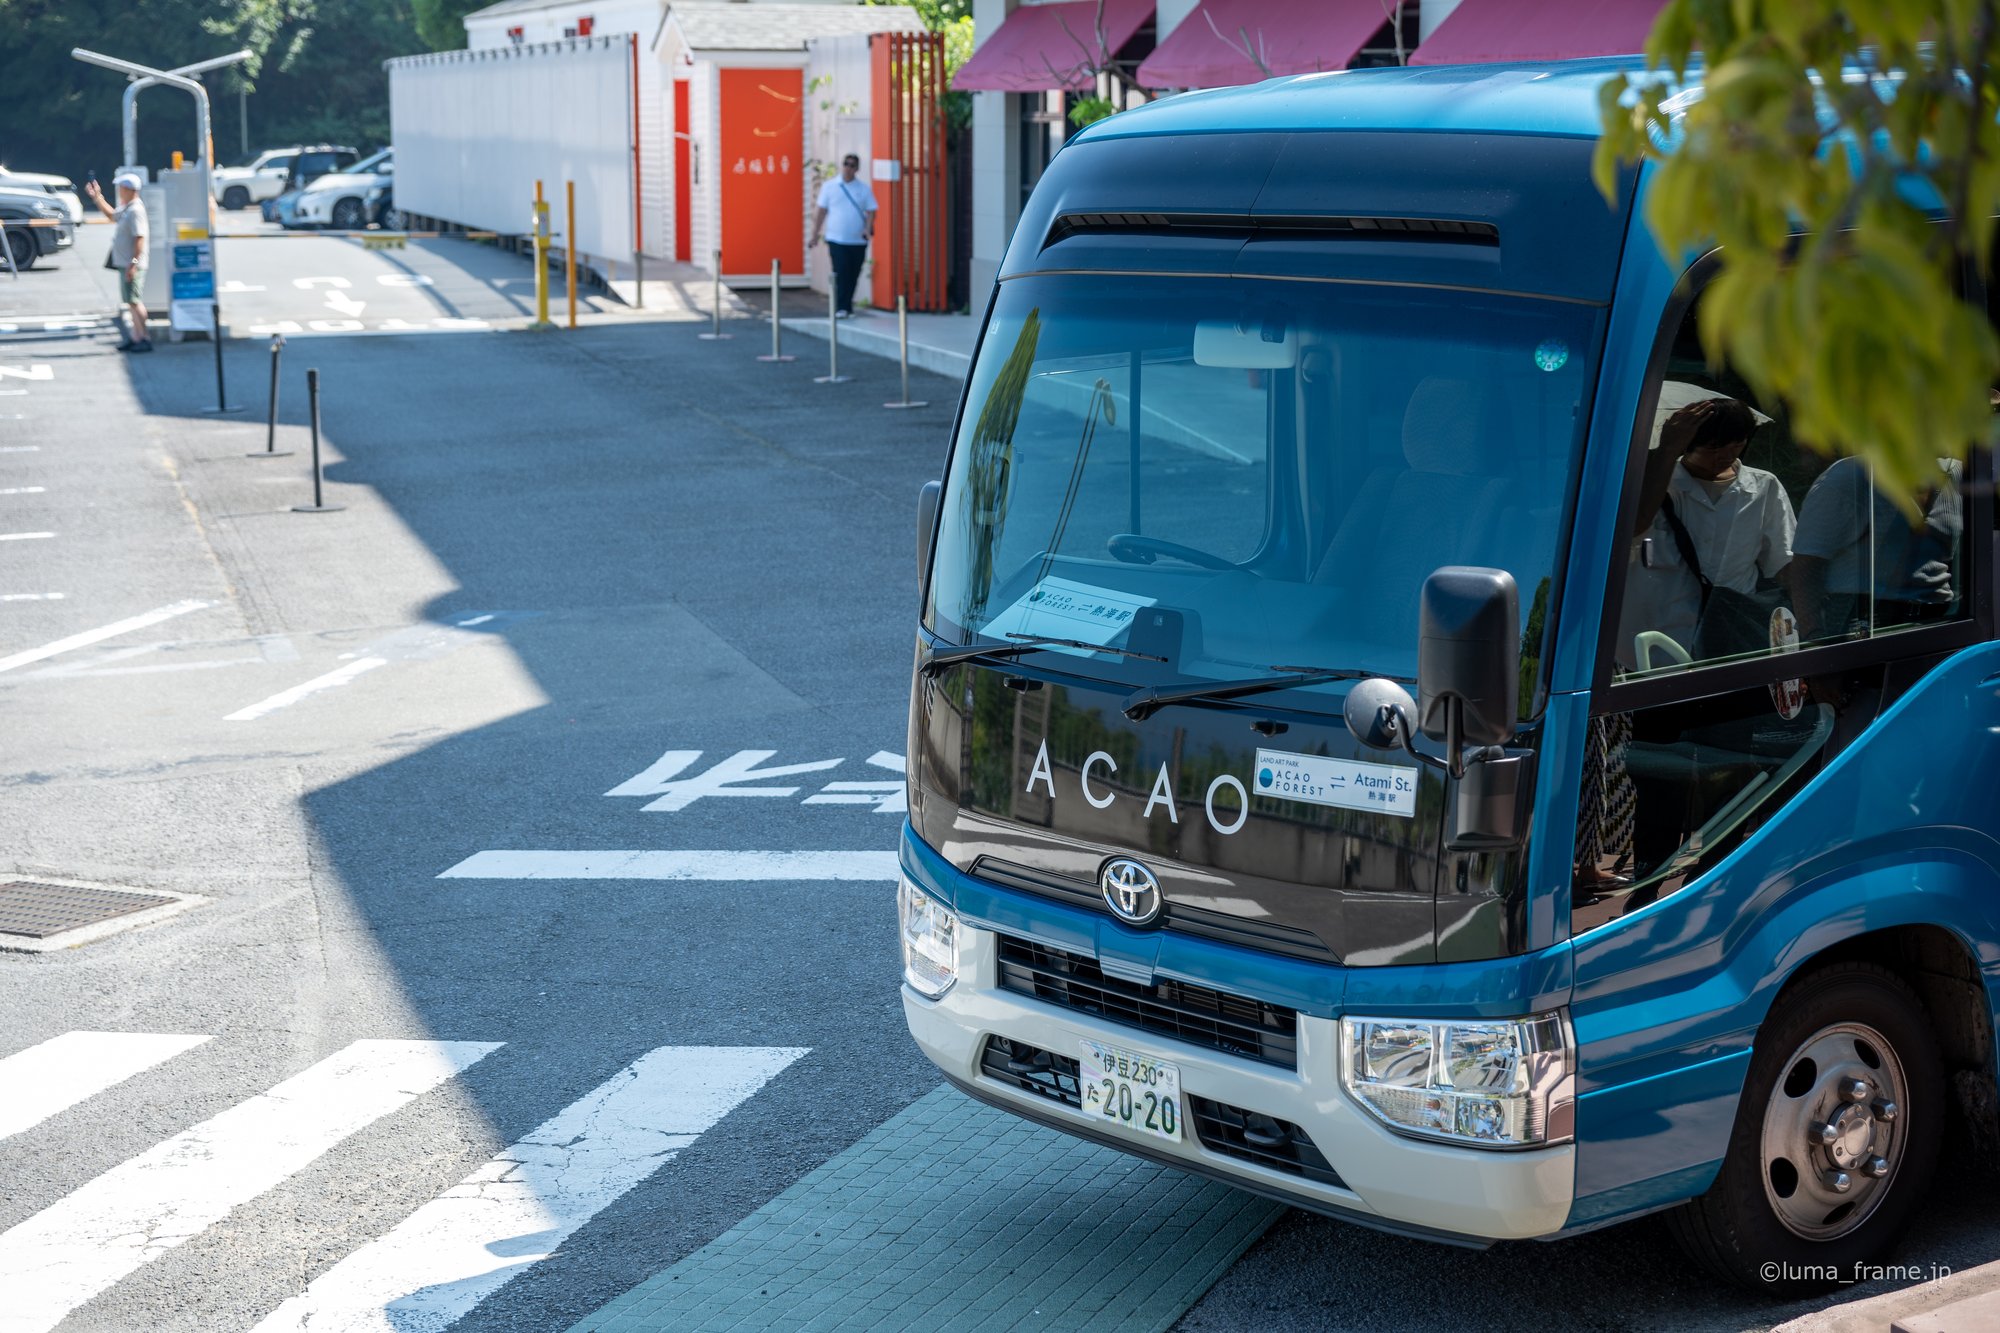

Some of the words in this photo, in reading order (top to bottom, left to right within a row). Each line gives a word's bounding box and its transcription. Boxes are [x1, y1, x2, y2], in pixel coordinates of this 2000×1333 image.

[1039, 598, 1077, 612] FOREST
[1045, 593, 1073, 603] ACAO
[1089, 605, 1132, 622] 熱海駅
[1260, 756, 1275, 764] LAND
[1275, 758, 1285, 766] ART
[1285, 759, 1300, 768] PARK
[1276, 770, 1311, 782] ACAO
[1354, 773, 1392, 790] Atami
[1395, 777, 1412, 792] St.
[1026, 738, 1248, 835] ACAO
[1275, 781, 1324, 796] FOREST
[1368, 790, 1397, 803] 熱海駅
[1102, 1078, 1175, 1134] 20-20
